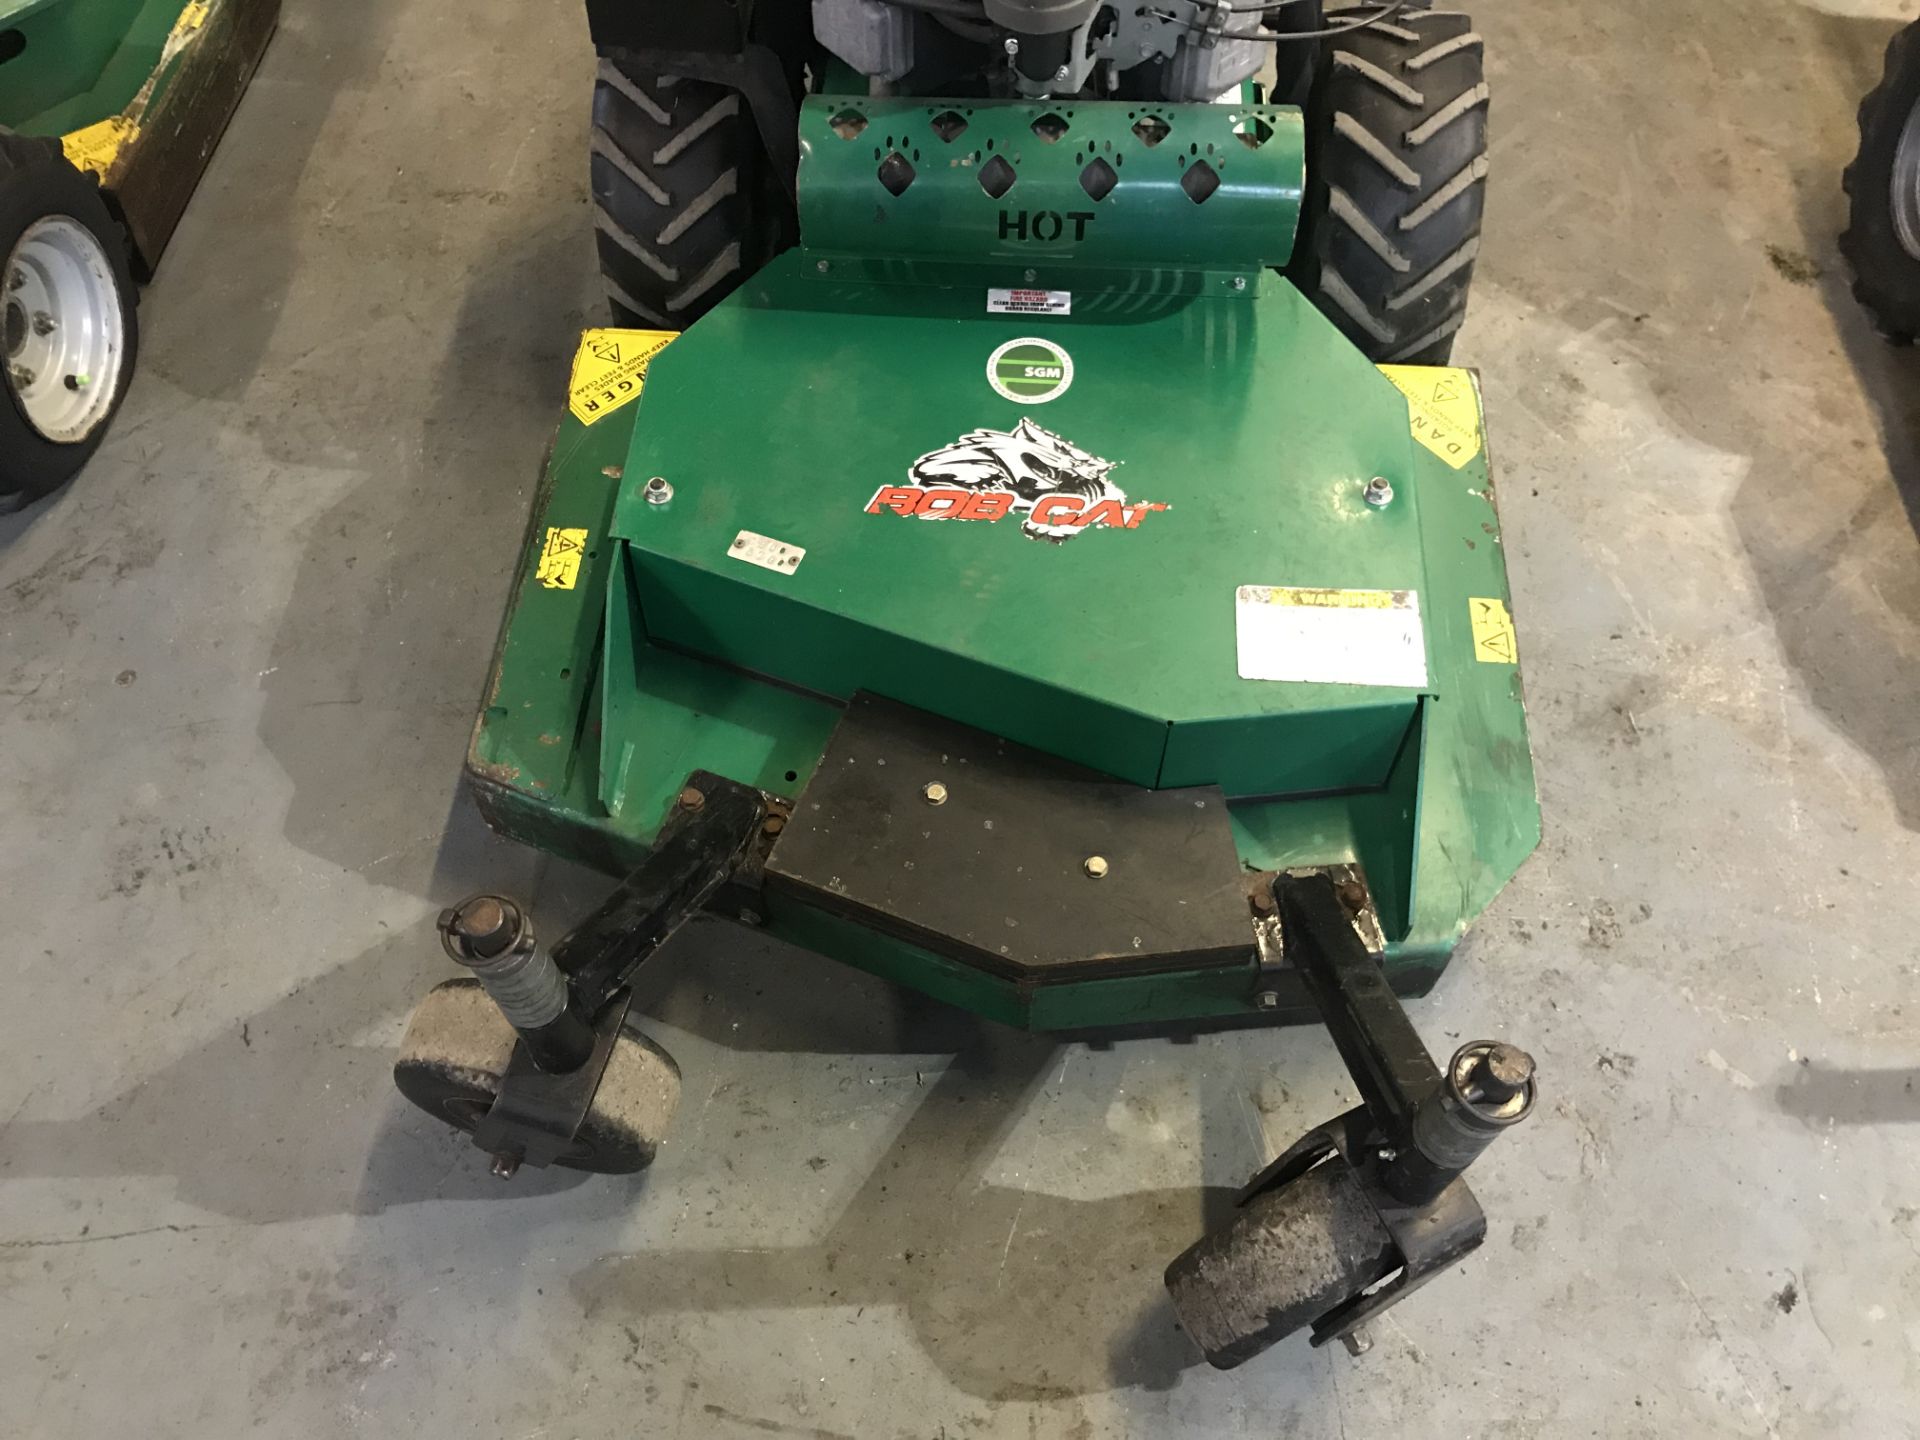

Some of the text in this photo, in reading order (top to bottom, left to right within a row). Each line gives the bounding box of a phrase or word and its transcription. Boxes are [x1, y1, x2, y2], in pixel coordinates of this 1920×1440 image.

[998, 209, 1096, 241] HOT
[624, 350, 650, 366] HANDS
[1024, 366, 1061, 378] SGM
[575, 380, 598, 396] CLEAR
[594, 372, 623, 391] BLADES
